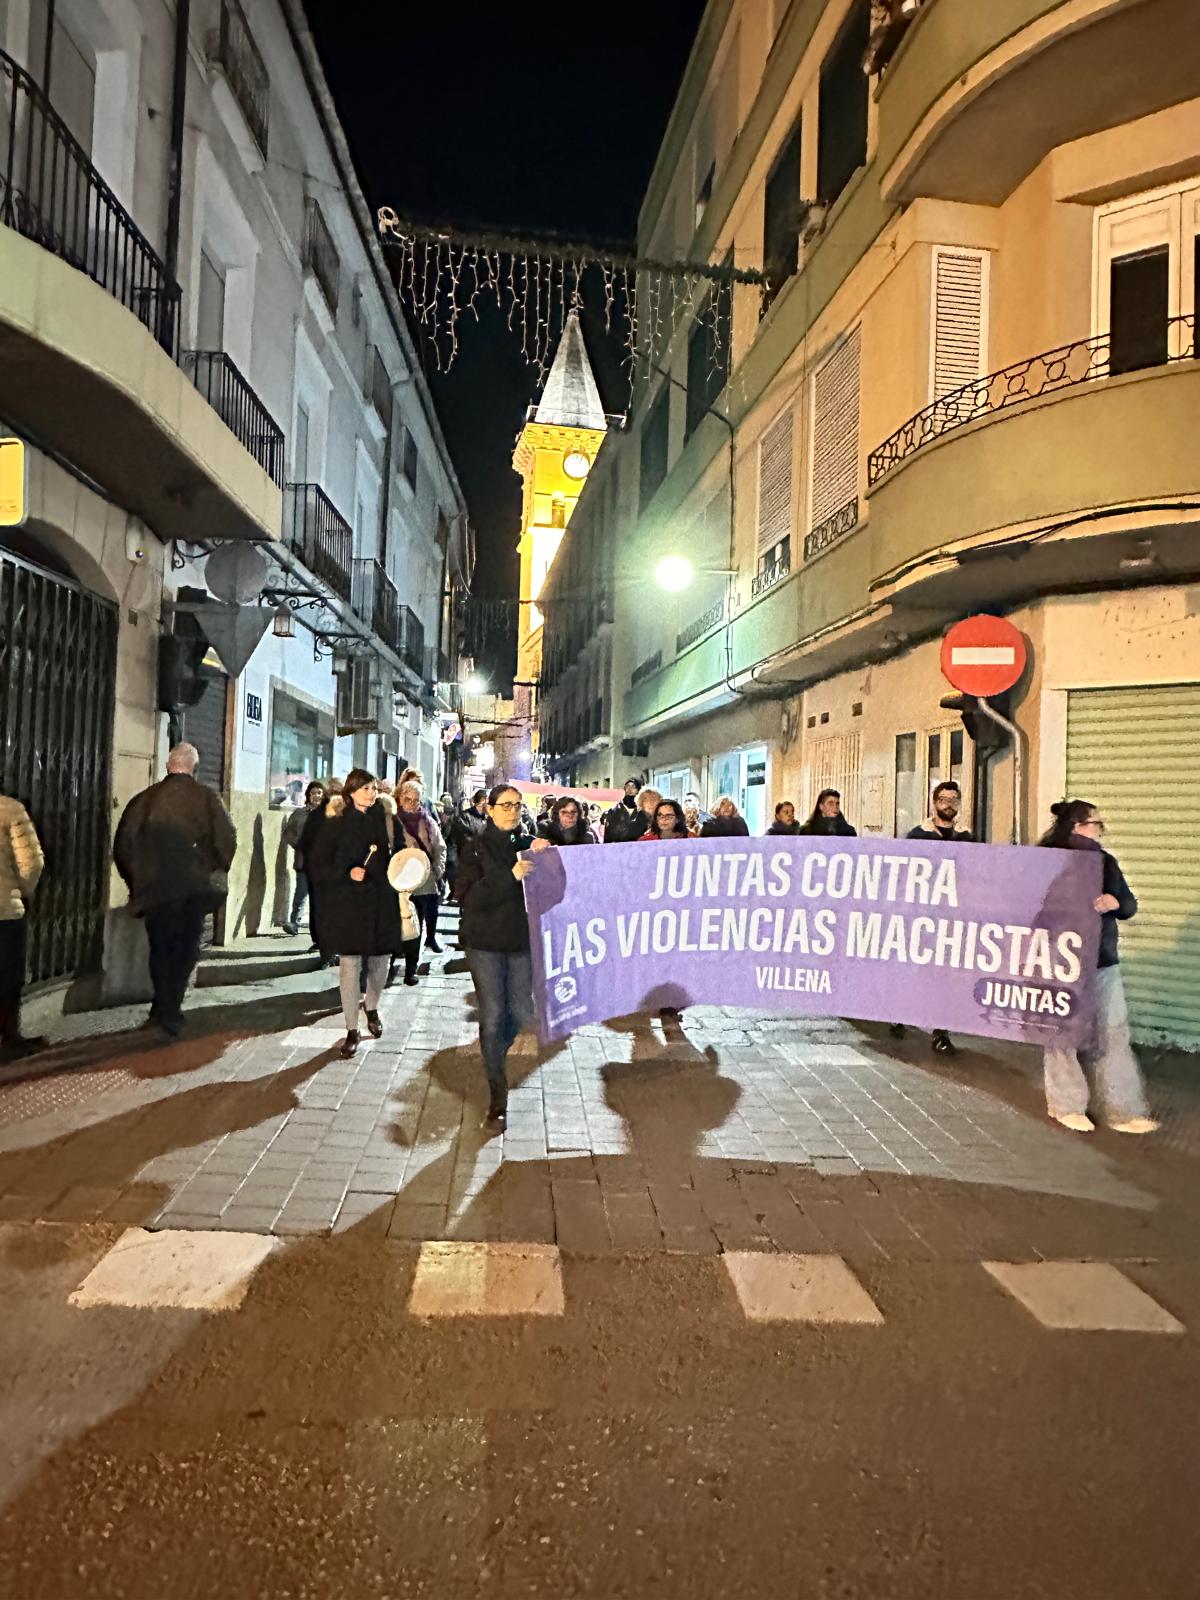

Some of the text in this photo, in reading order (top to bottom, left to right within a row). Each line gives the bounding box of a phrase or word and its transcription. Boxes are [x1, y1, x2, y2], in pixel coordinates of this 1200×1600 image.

[649, 852, 959, 908] JUNTAS CONTRA
[543, 907, 1082, 983] LAS VIOLENCIAS MACHISTAS
[755, 966, 832, 993] VILLENA
[981, 981, 1071, 1017] JUNTAS
